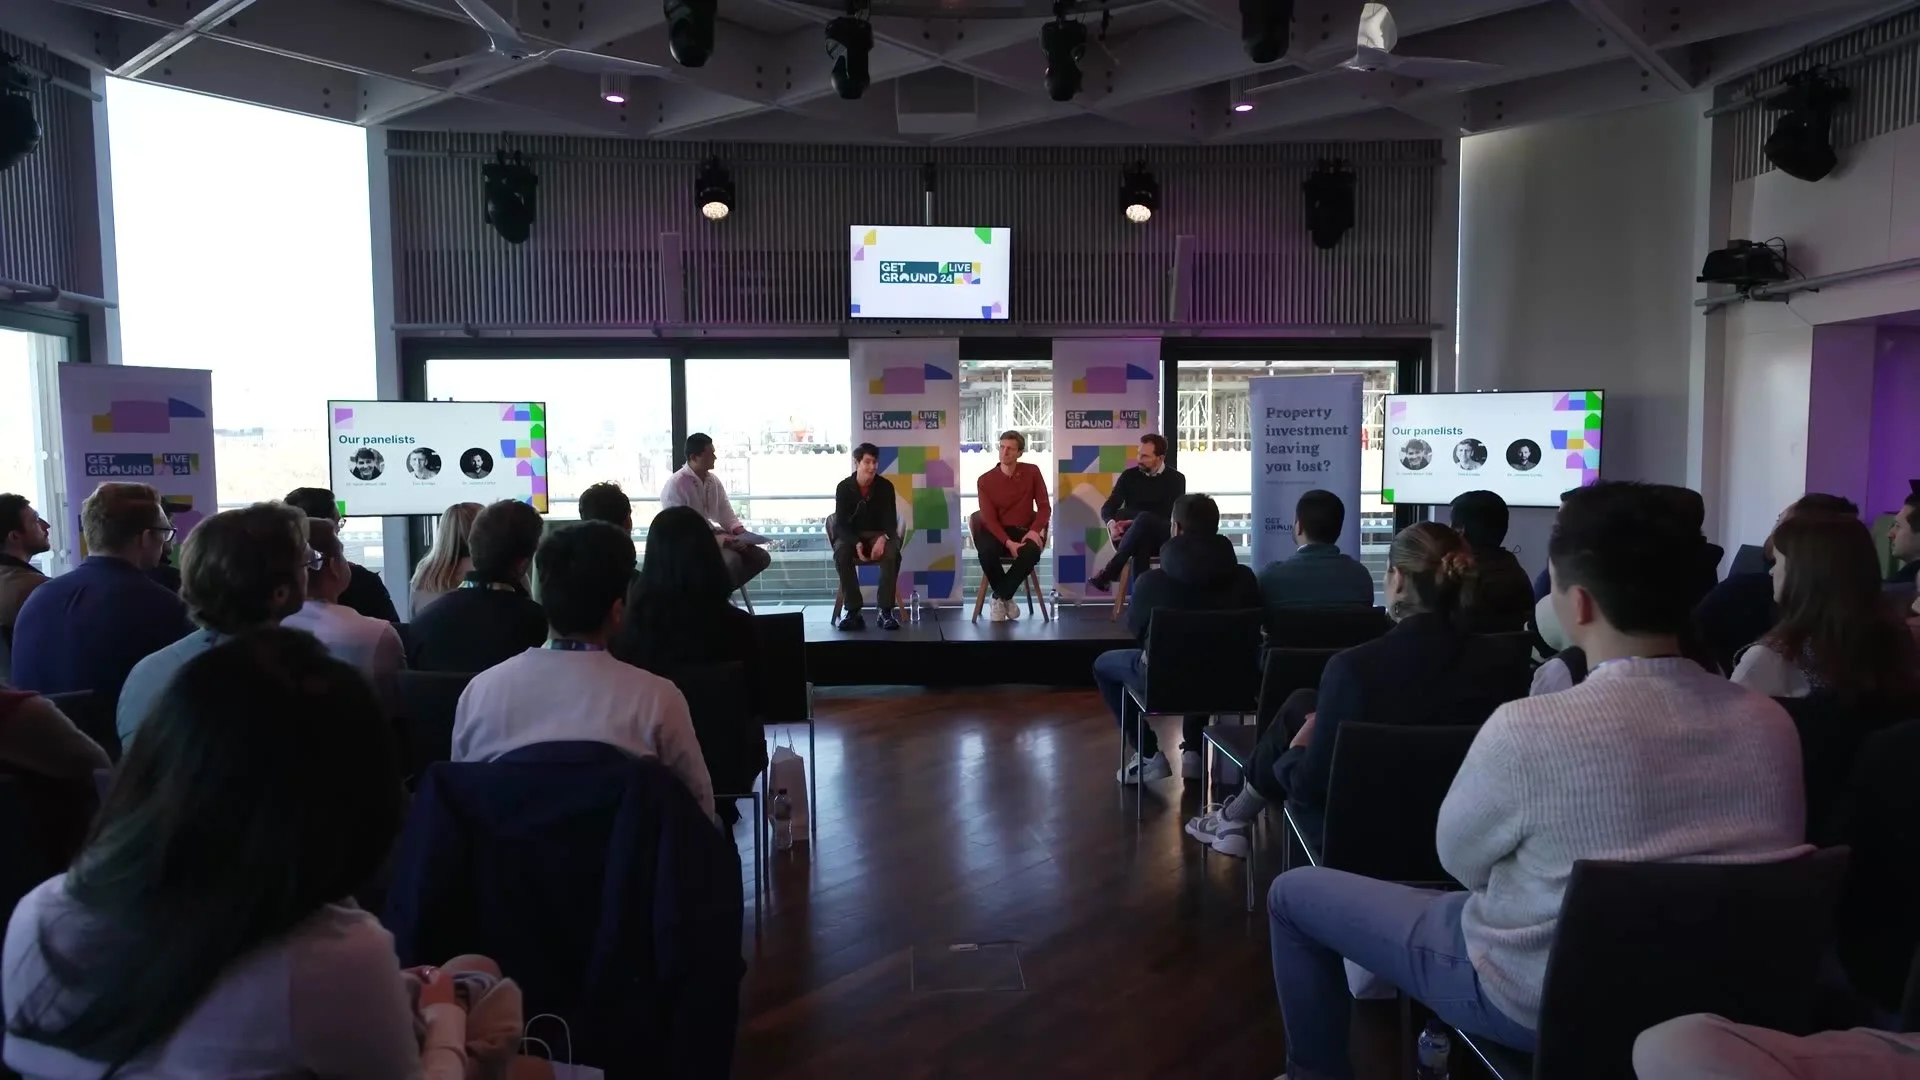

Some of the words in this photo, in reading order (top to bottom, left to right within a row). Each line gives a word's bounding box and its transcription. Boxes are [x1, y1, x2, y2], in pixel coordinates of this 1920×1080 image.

[881, 262, 906, 272] GET
[949, 263, 971, 272] LIVE
[940, 274, 953, 283] 24
[864, 412, 884, 420] GET
[1067, 411, 1087, 419] GET
[1121, 411, 1139, 419] LIVE
[1265, 407, 1333, 421] Property
[1265, 424, 1349, 437] investment
[1392, 426, 1411, 435] Our
[1414, 427, 1463, 437] panelists
[339, 435, 360, 444] Our
[363, 435, 416, 446] panelists
[1265, 442, 1320, 457] leaving
[87, 455, 116, 464] GET
[164, 454, 188, 463] LIVE
[174, 465, 188, 474] 24
[1265, 462, 1291, 475] you
[1296, 460, 1331, 473] lost?
